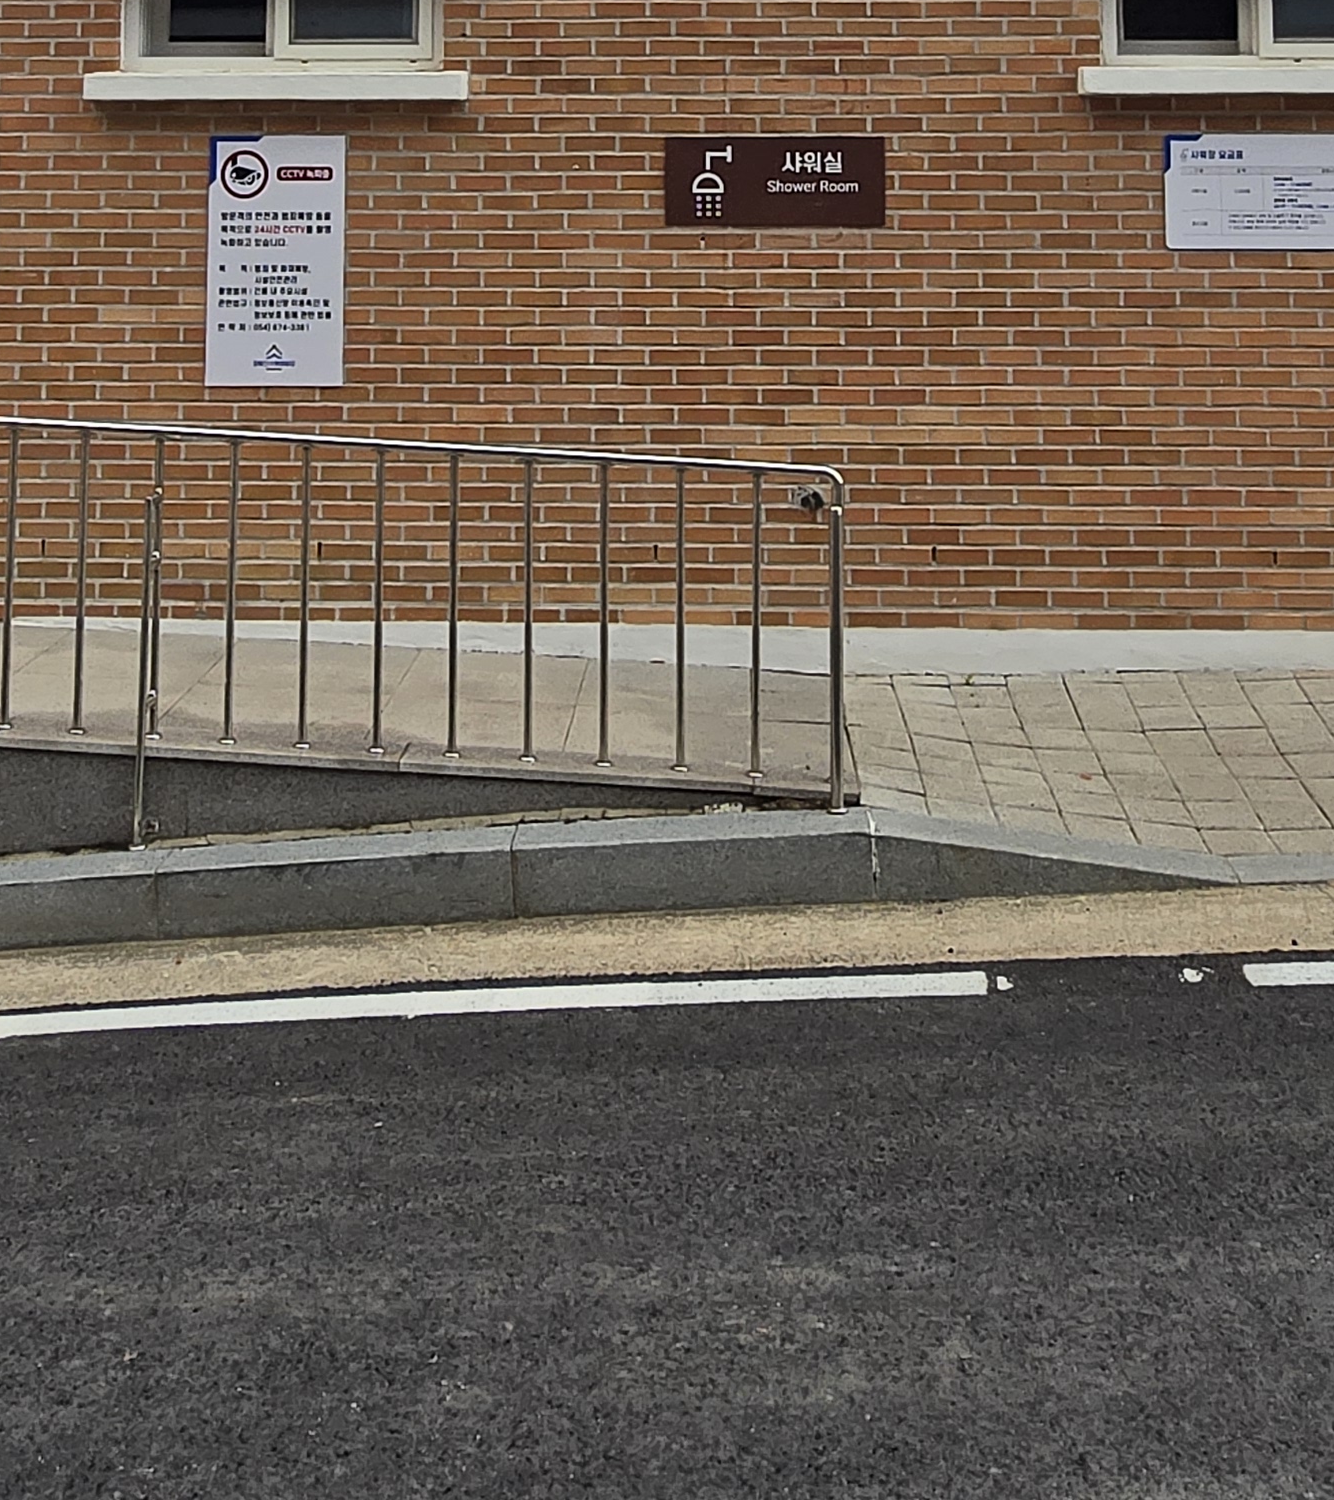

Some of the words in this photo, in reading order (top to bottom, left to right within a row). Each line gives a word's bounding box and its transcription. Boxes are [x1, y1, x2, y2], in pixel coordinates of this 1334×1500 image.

[781, 151, 843, 173] 샤워실
[280, 169, 305, 178] CCTV
[766, 180, 816, 193] Shower
[820, 181, 859, 193] Room
[254, 225, 280, 234] 24시간
